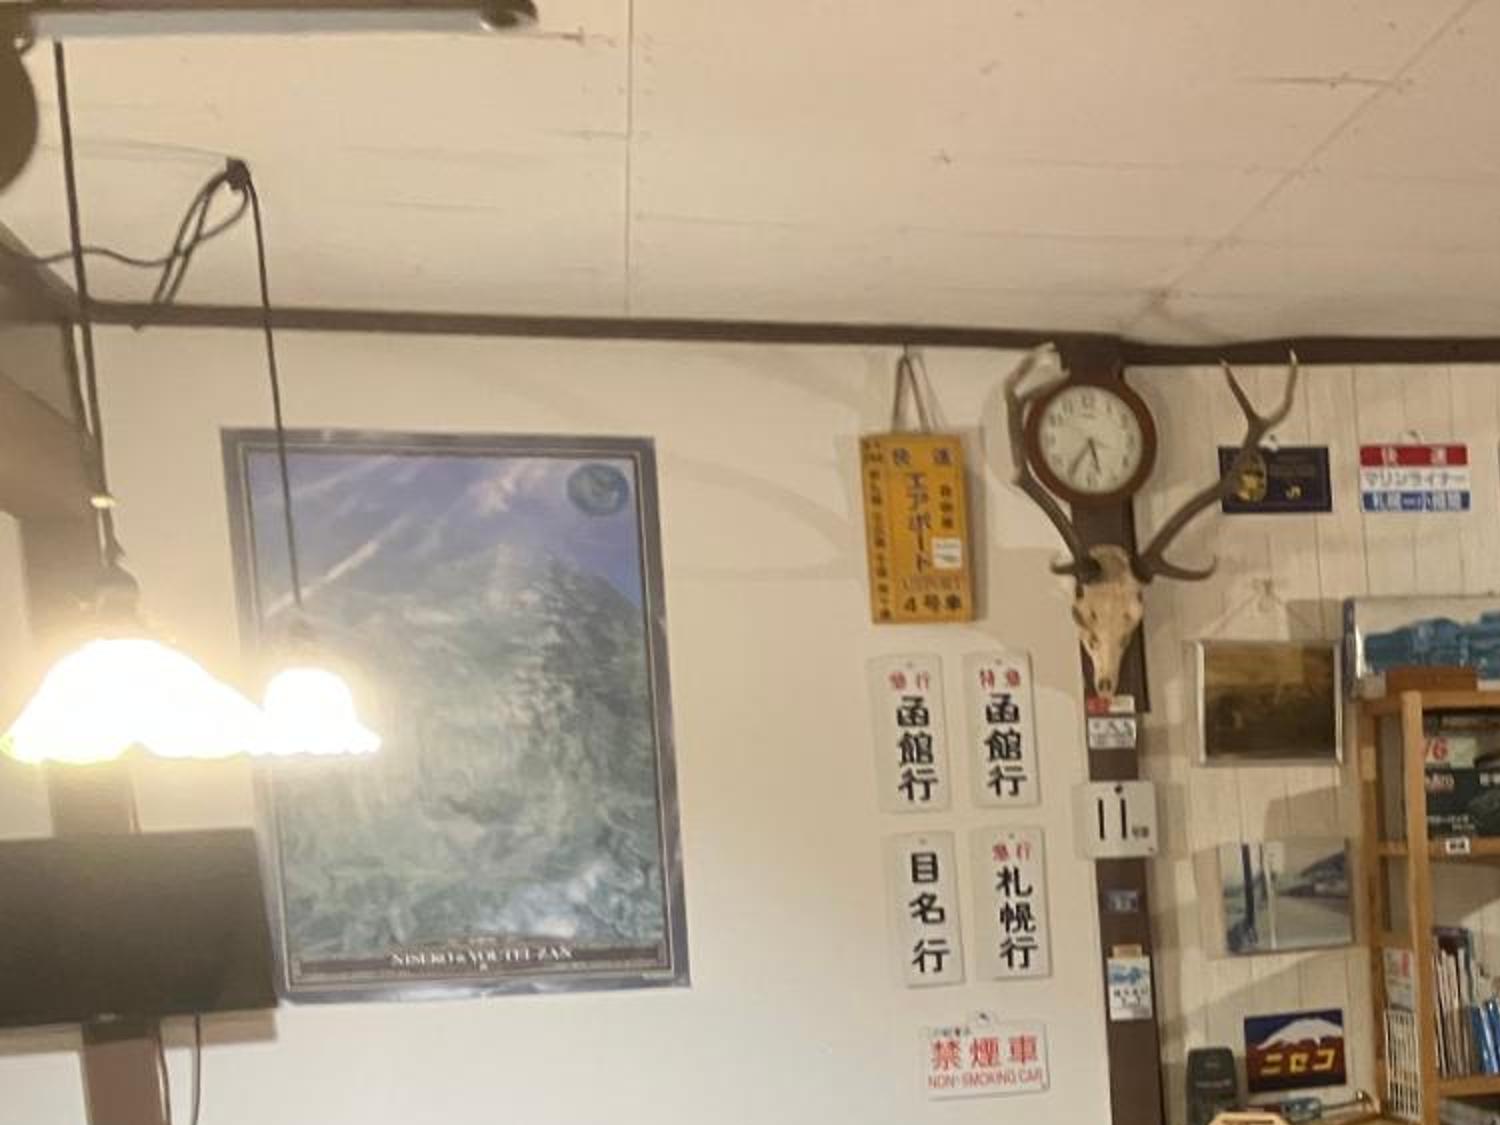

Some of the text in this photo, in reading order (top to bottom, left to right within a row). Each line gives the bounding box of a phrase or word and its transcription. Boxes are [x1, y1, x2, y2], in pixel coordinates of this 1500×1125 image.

[1366, 471, 1466, 487] マリンライナー
[895, 695, 938, 802] 函館行
[984, 692, 1028, 798] 函館行
[908, 851, 951, 974] 目名行
[995, 865, 1040, 970] 札幌行
[930, 1034, 1038, 1071] 禁煙車
[1260, 1048, 1336, 1076] ニセコ
